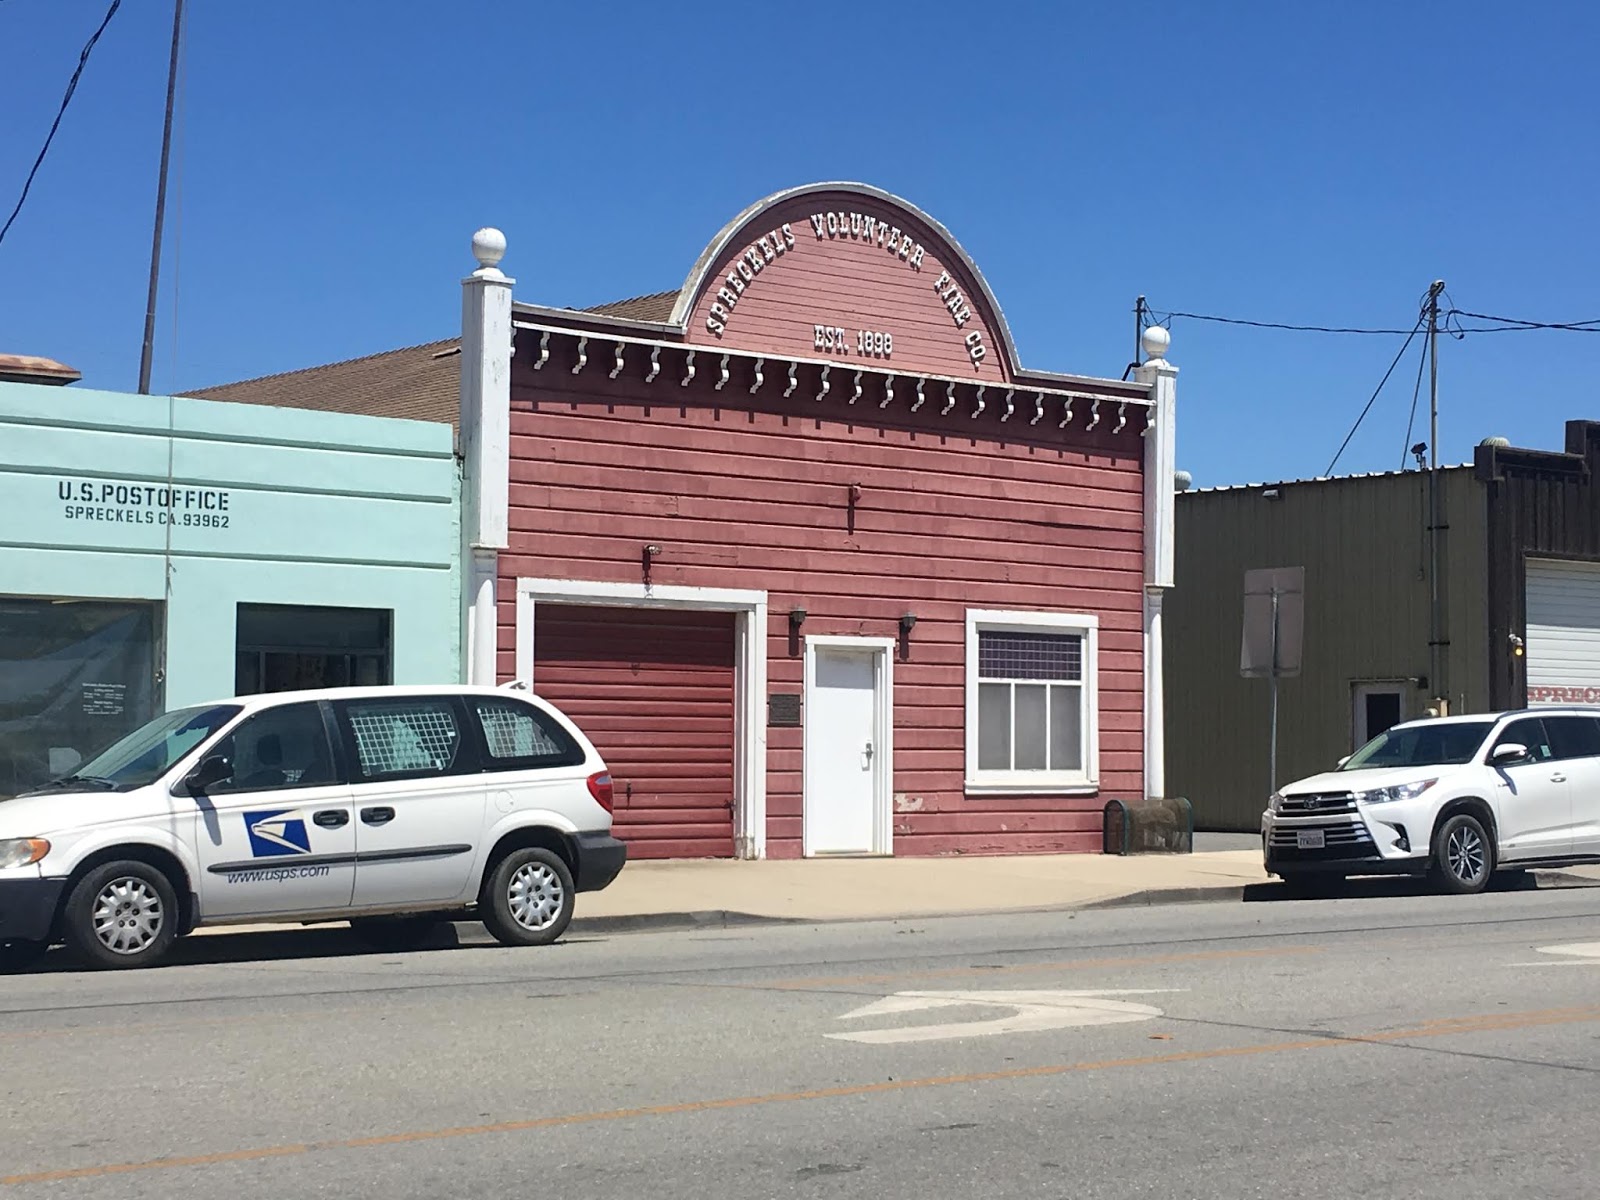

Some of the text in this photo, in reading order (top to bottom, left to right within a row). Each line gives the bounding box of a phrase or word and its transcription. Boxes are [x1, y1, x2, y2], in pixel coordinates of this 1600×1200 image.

[706, 222, 796, 335] SPRECKELS
[810, 211, 926, 269] VOLUNTEER
[933, 270, 972, 327] FIRE
[813, 324, 893, 357] EST. 1898
[65, 505, 154, 524] SPRECKELS
[227, 865, 330, 884] www.usps.com
